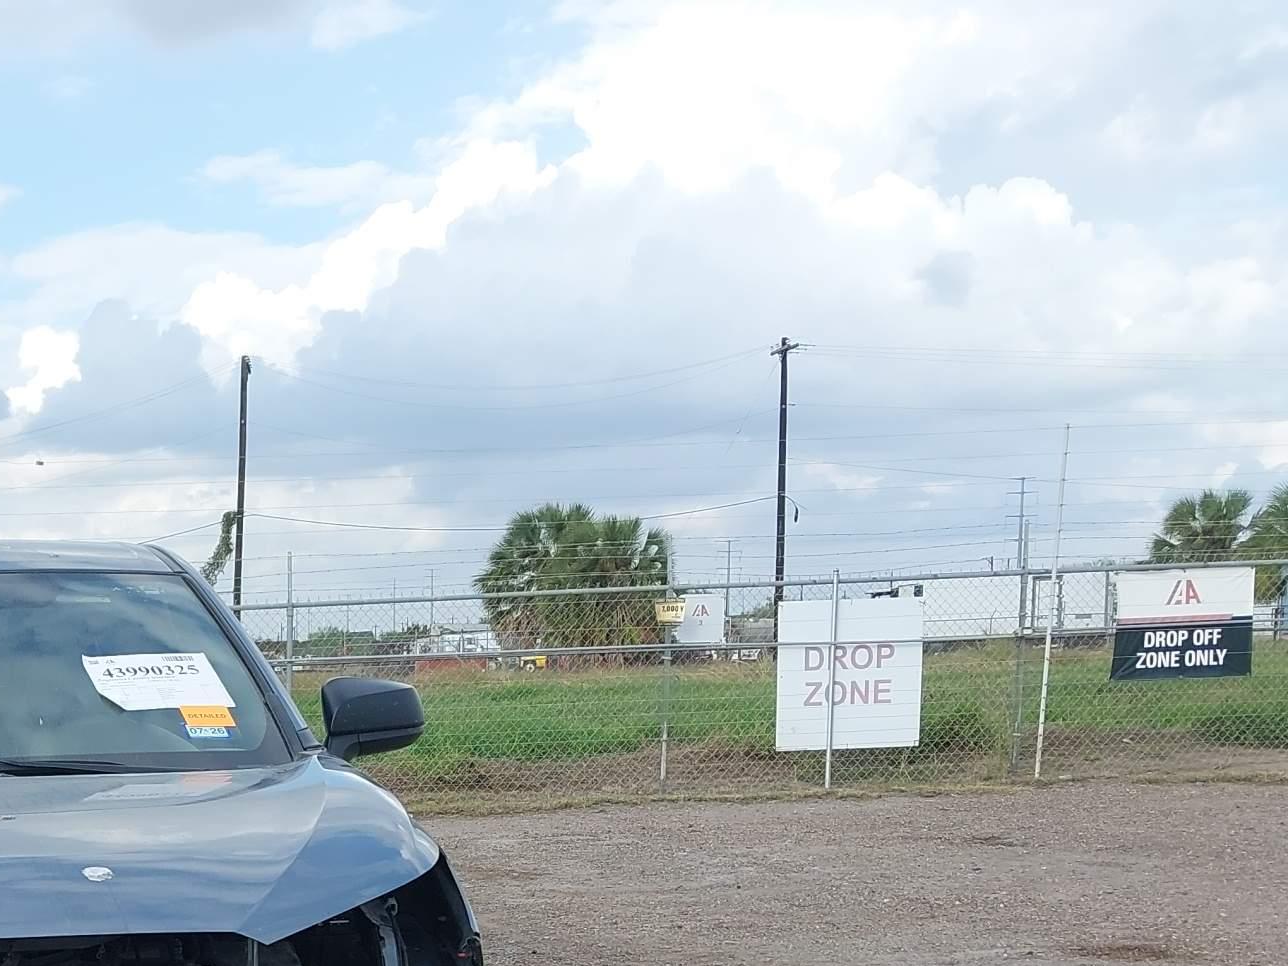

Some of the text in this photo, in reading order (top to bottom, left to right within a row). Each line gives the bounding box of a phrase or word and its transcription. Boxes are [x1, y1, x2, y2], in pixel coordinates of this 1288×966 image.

[1144, 628, 1222, 648] DROP OFF
[804, 643, 896, 671] DROP
[1135, 648, 1228, 669] ZONE ONLY
[102, 664, 199, 679] 43990325
[803, 679, 893, 707] ZONE
[189, 727, 225, 735] 07 26
